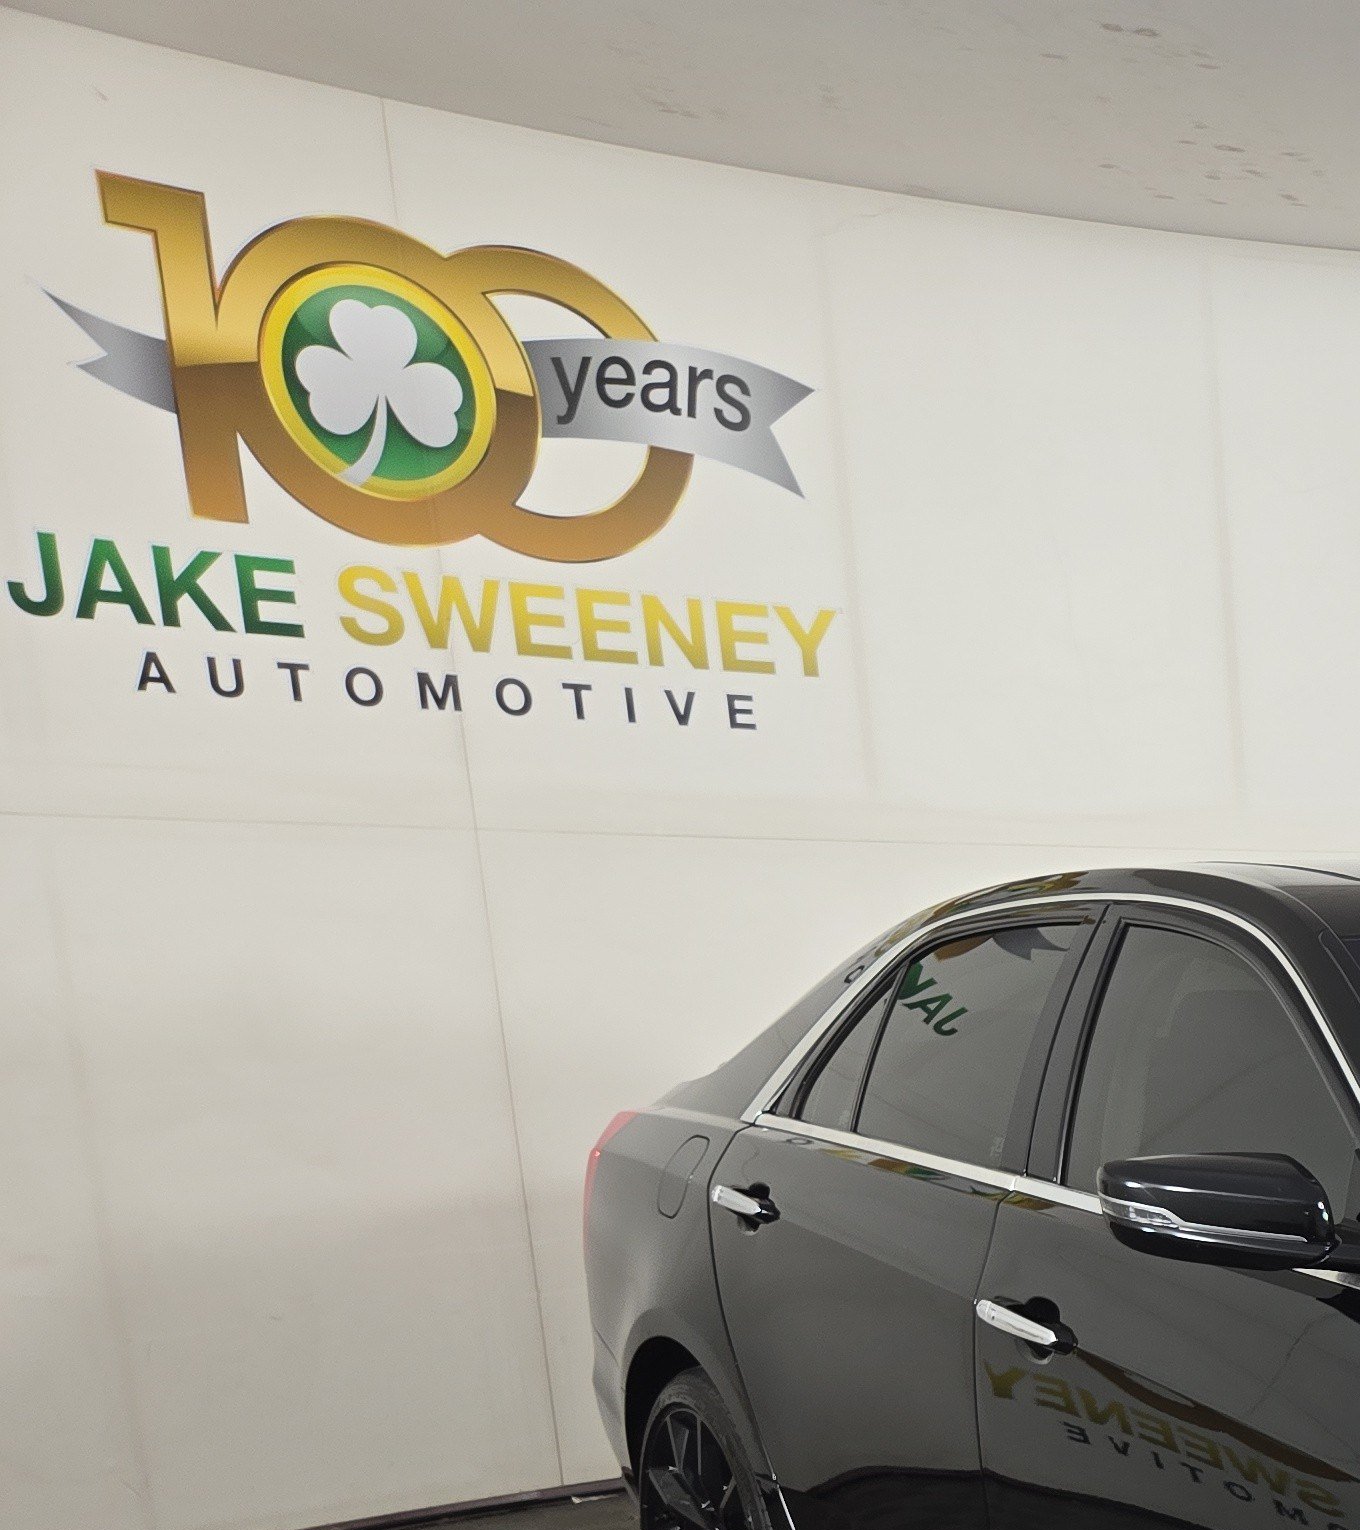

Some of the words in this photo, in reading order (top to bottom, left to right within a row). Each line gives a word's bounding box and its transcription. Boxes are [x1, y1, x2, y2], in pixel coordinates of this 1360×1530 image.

[96, 169, 693, 564] 100
[552, 352, 752, 432] years
[7, 530, 307, 640] JAKE
[338, 564, 837, 678] SWEENEY
[138, 652, 757, 730] AUTOMOTIVE
